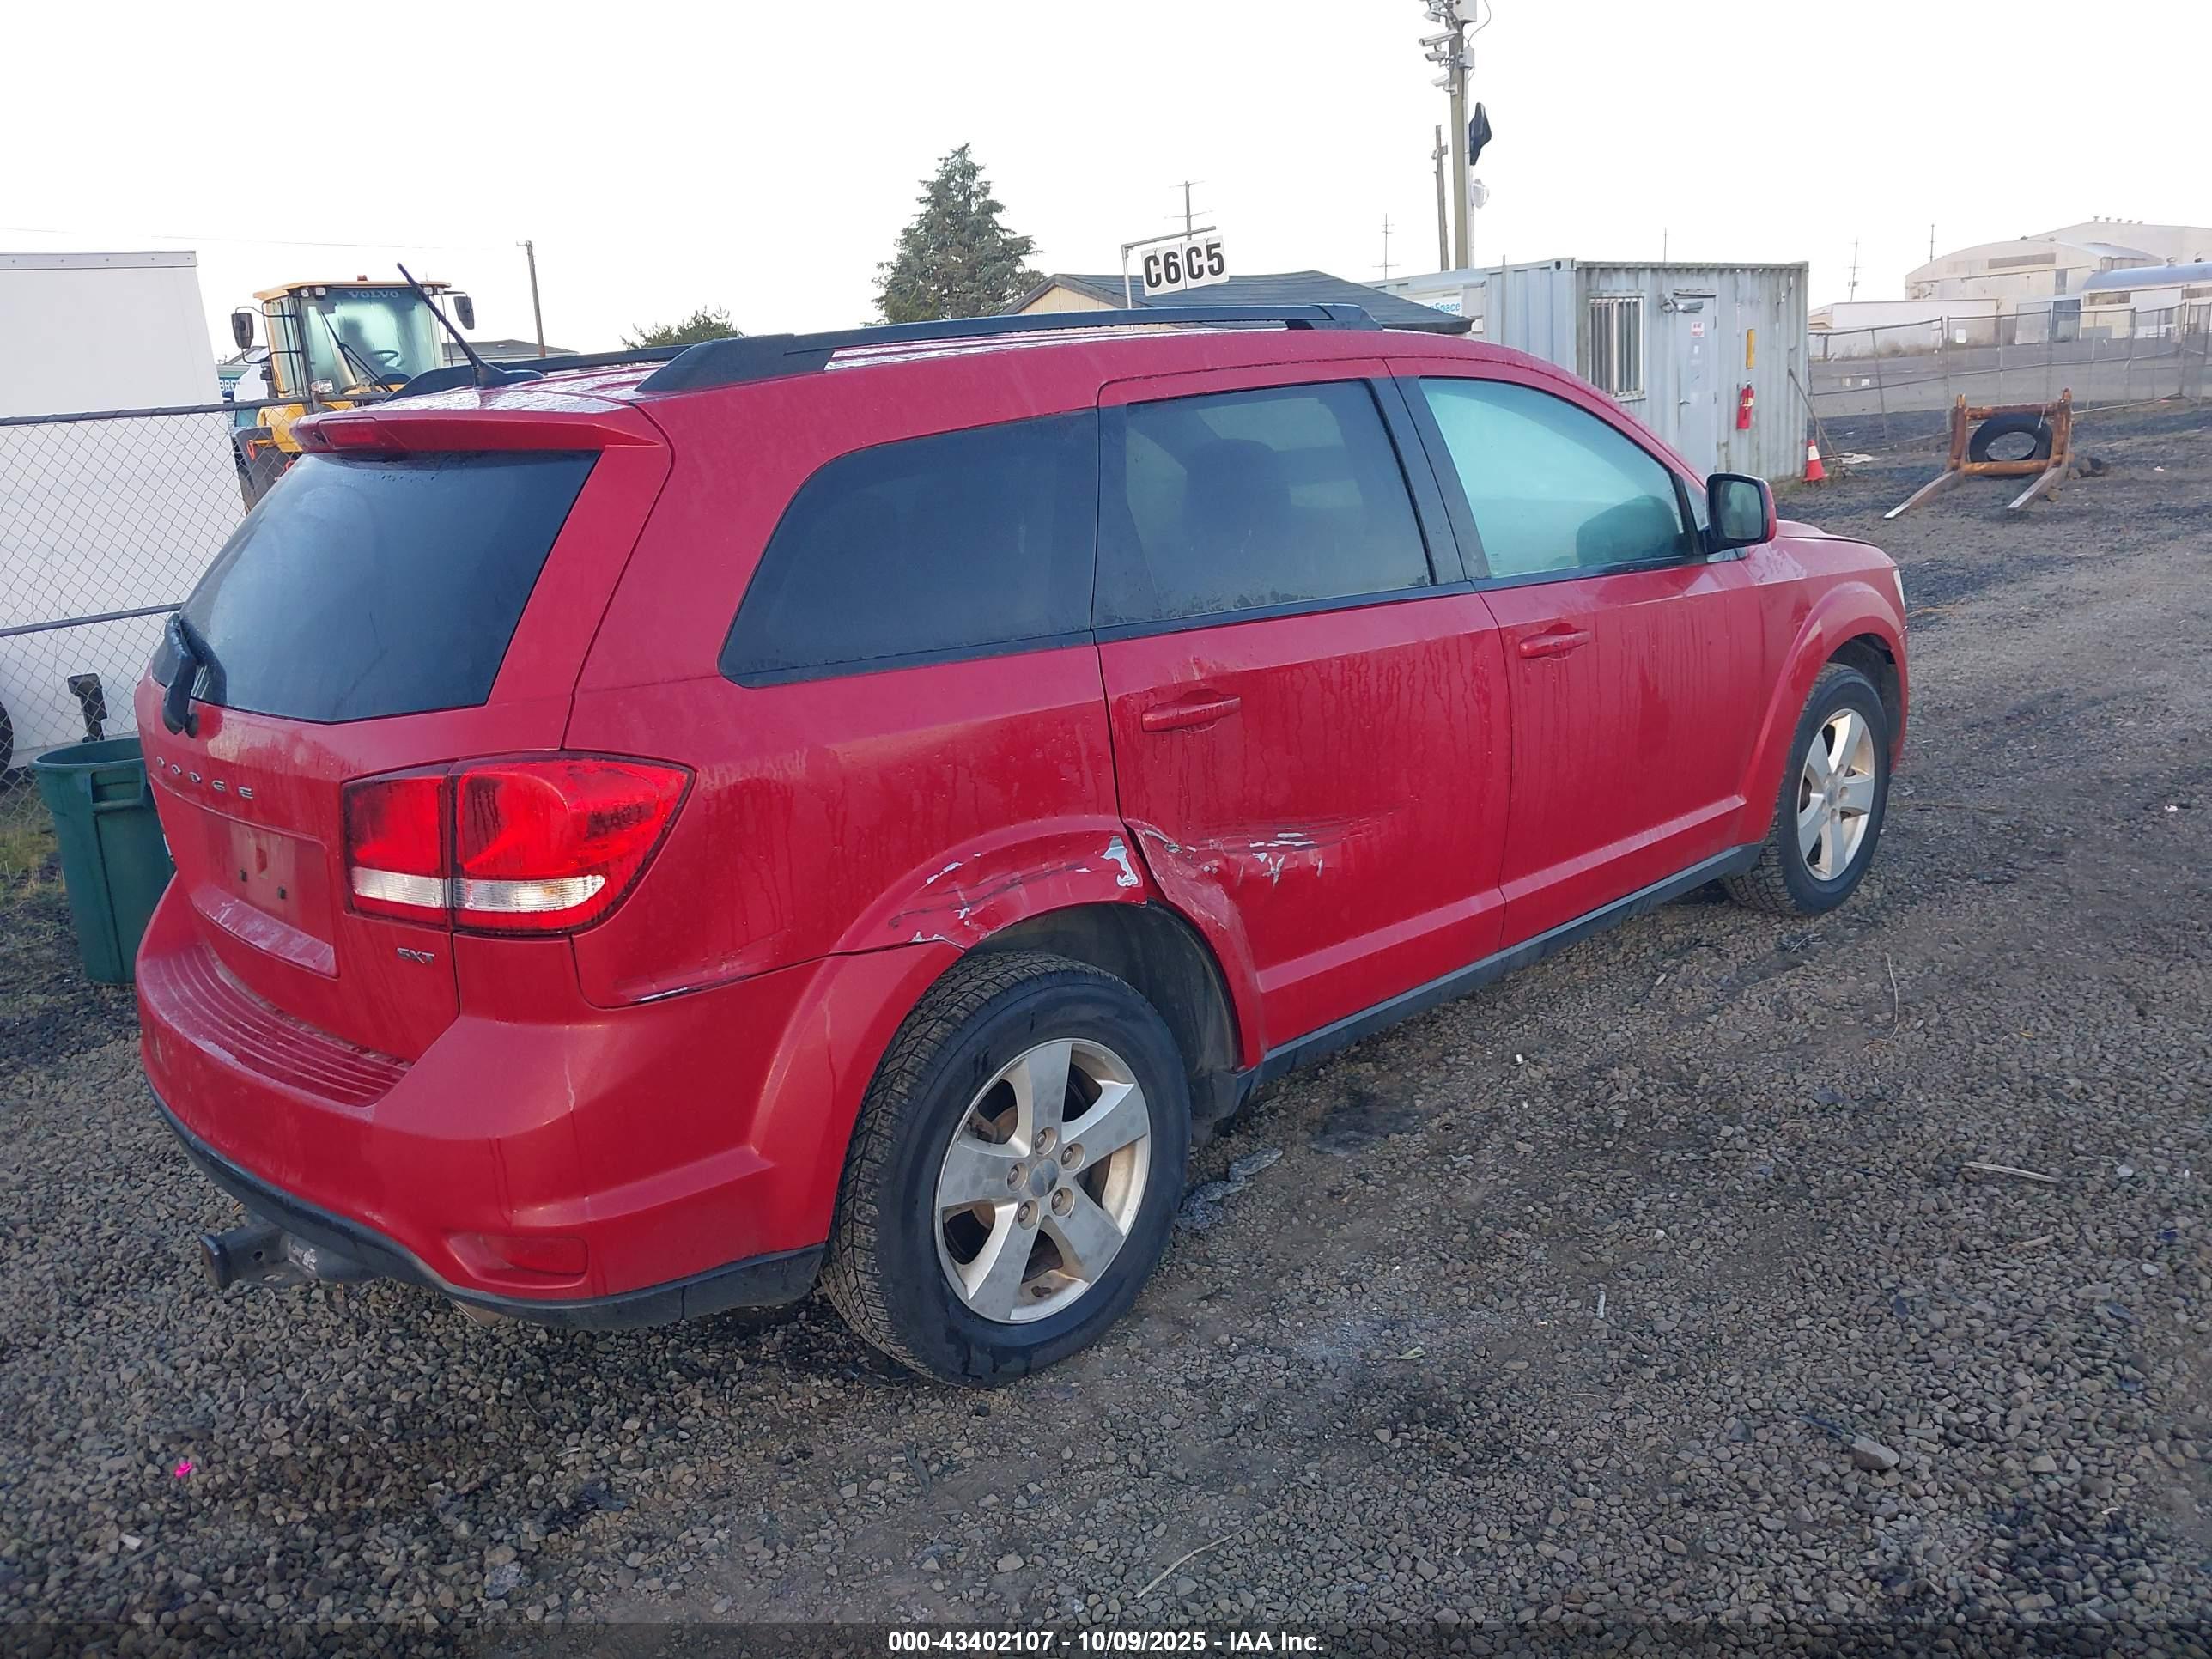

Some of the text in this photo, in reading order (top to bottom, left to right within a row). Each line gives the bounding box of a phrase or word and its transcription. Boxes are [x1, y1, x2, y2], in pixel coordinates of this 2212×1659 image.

[1144, 242, 1224, 288] C6 C5
[156, 756, 253, 799] DODGE
[397, 947, 434, 963] SXT
